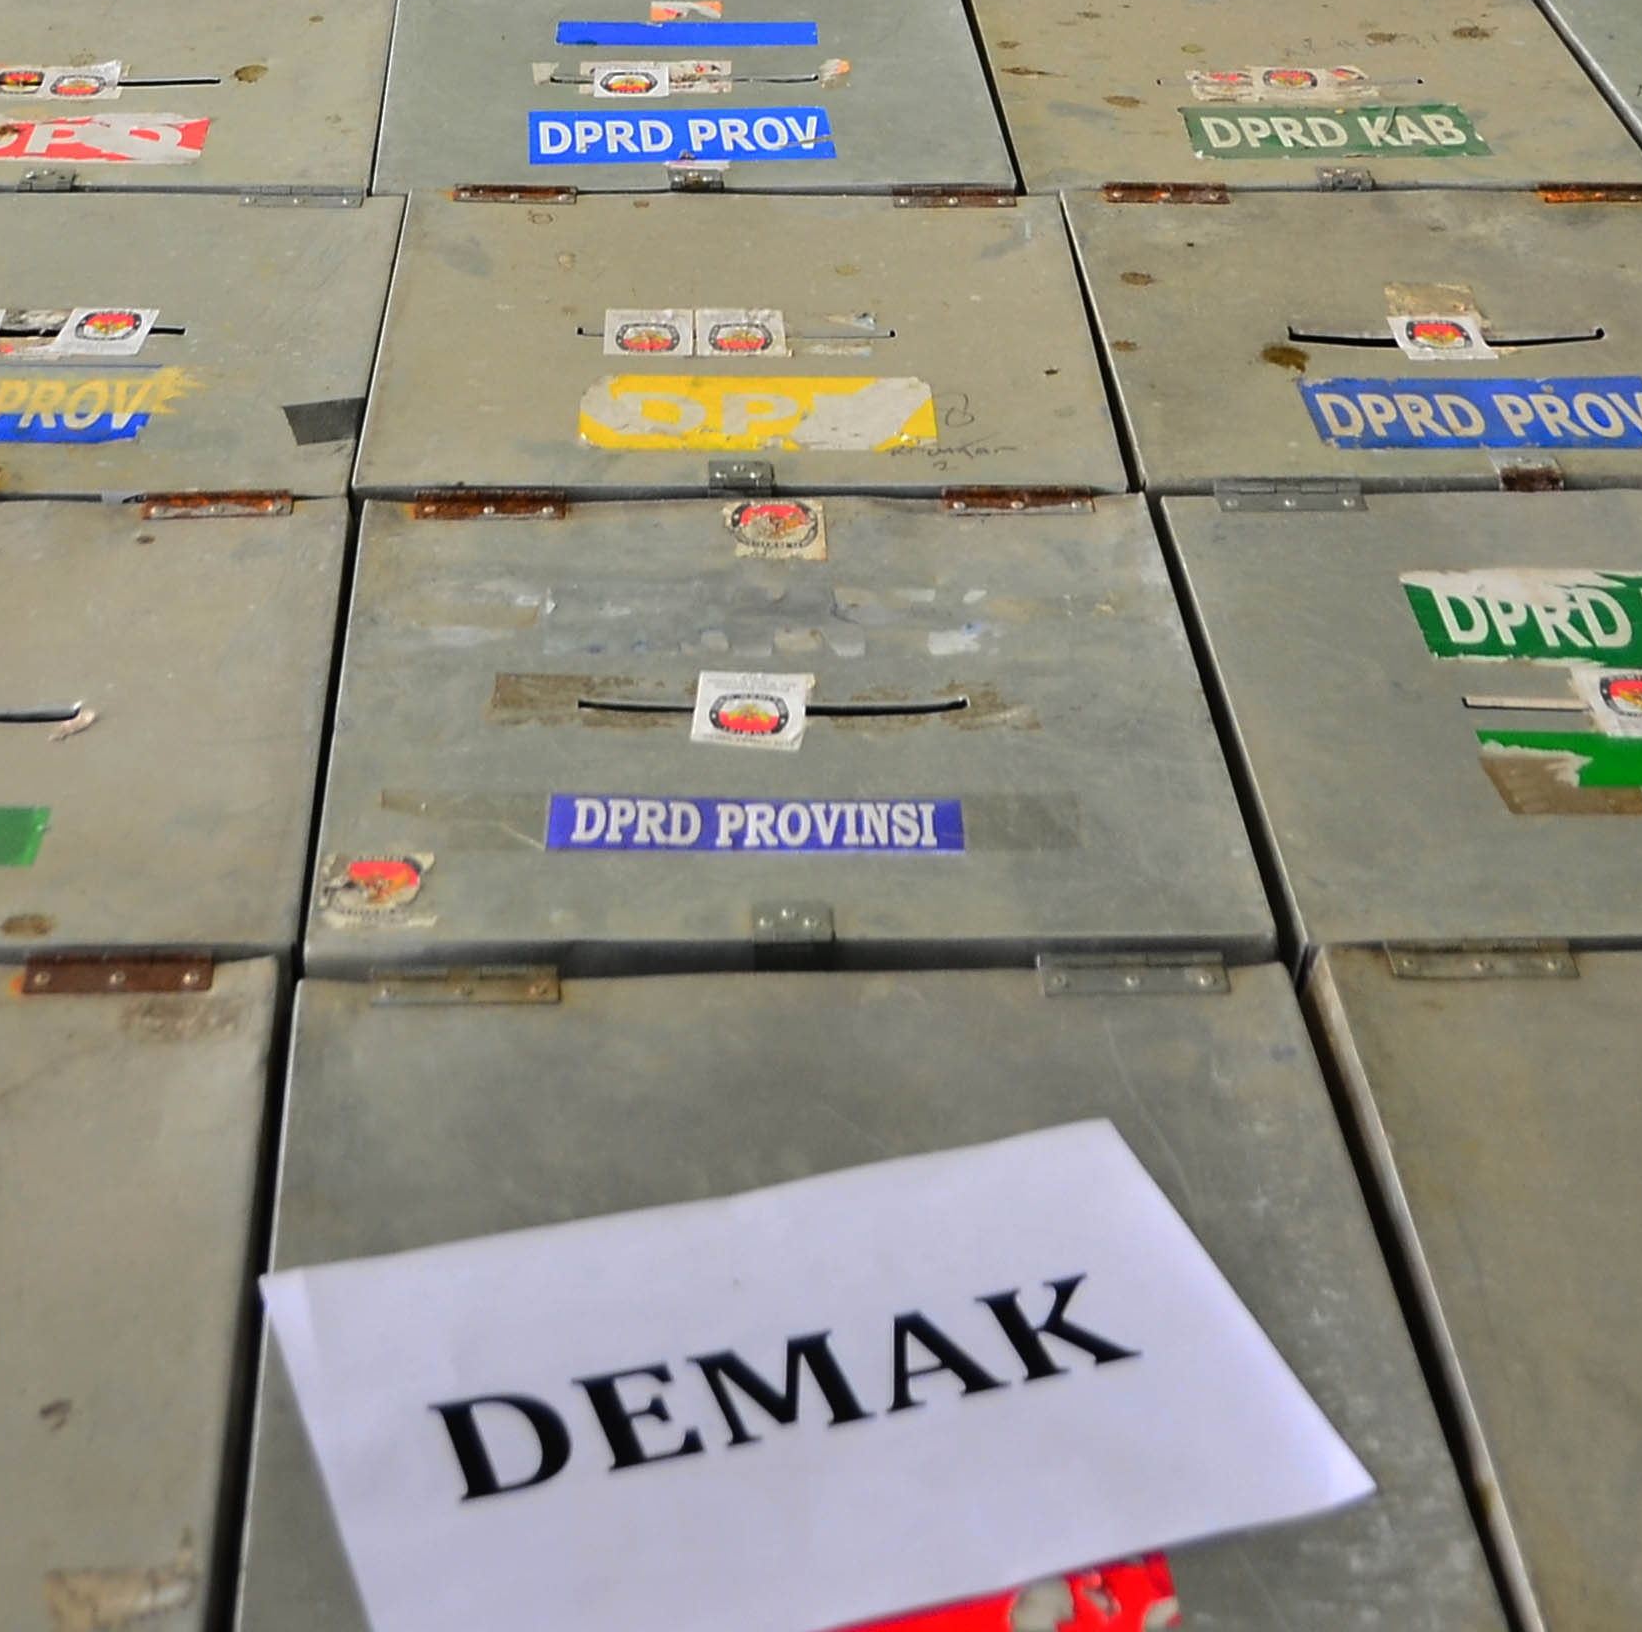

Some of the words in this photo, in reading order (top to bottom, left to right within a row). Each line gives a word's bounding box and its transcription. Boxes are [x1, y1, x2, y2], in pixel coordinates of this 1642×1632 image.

[538, 118, 674, 155] DPRD
[689, 114, 821, 153] PROV
[1199, 114, 1350, 150] DPRD
[1357, 111, 1469, 149] KAB
[1315, 391, 1483, 439] DPRD
[1428, 582, 1634, 649] DPRD
[569, 798, 701, 848] DPRD
[714, 801, 938, 848] PROVINSI
[427, 1272, 1143, 1504] DEMAK
